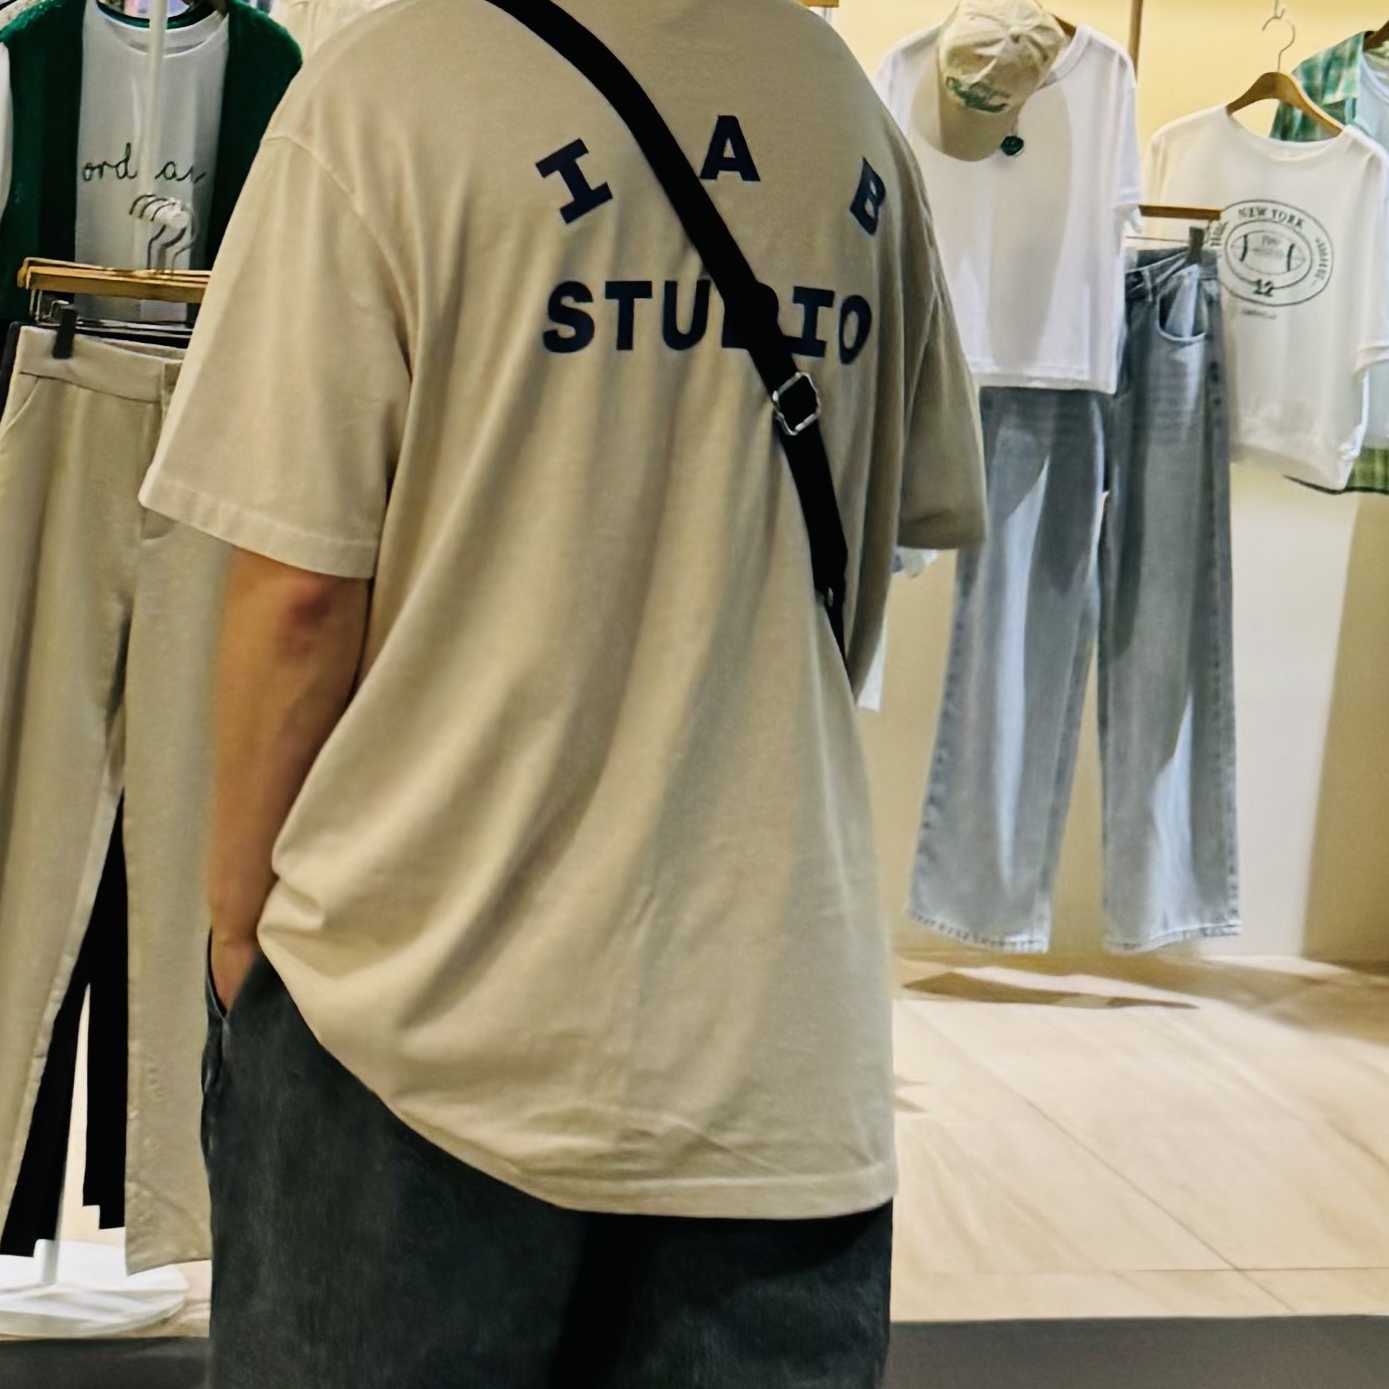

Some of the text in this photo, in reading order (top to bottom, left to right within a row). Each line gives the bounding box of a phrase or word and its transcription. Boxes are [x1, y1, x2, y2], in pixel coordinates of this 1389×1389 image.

[1238, 206, 1305, 228] NEW YORK
[542, 279, 873, 366] STUIO
